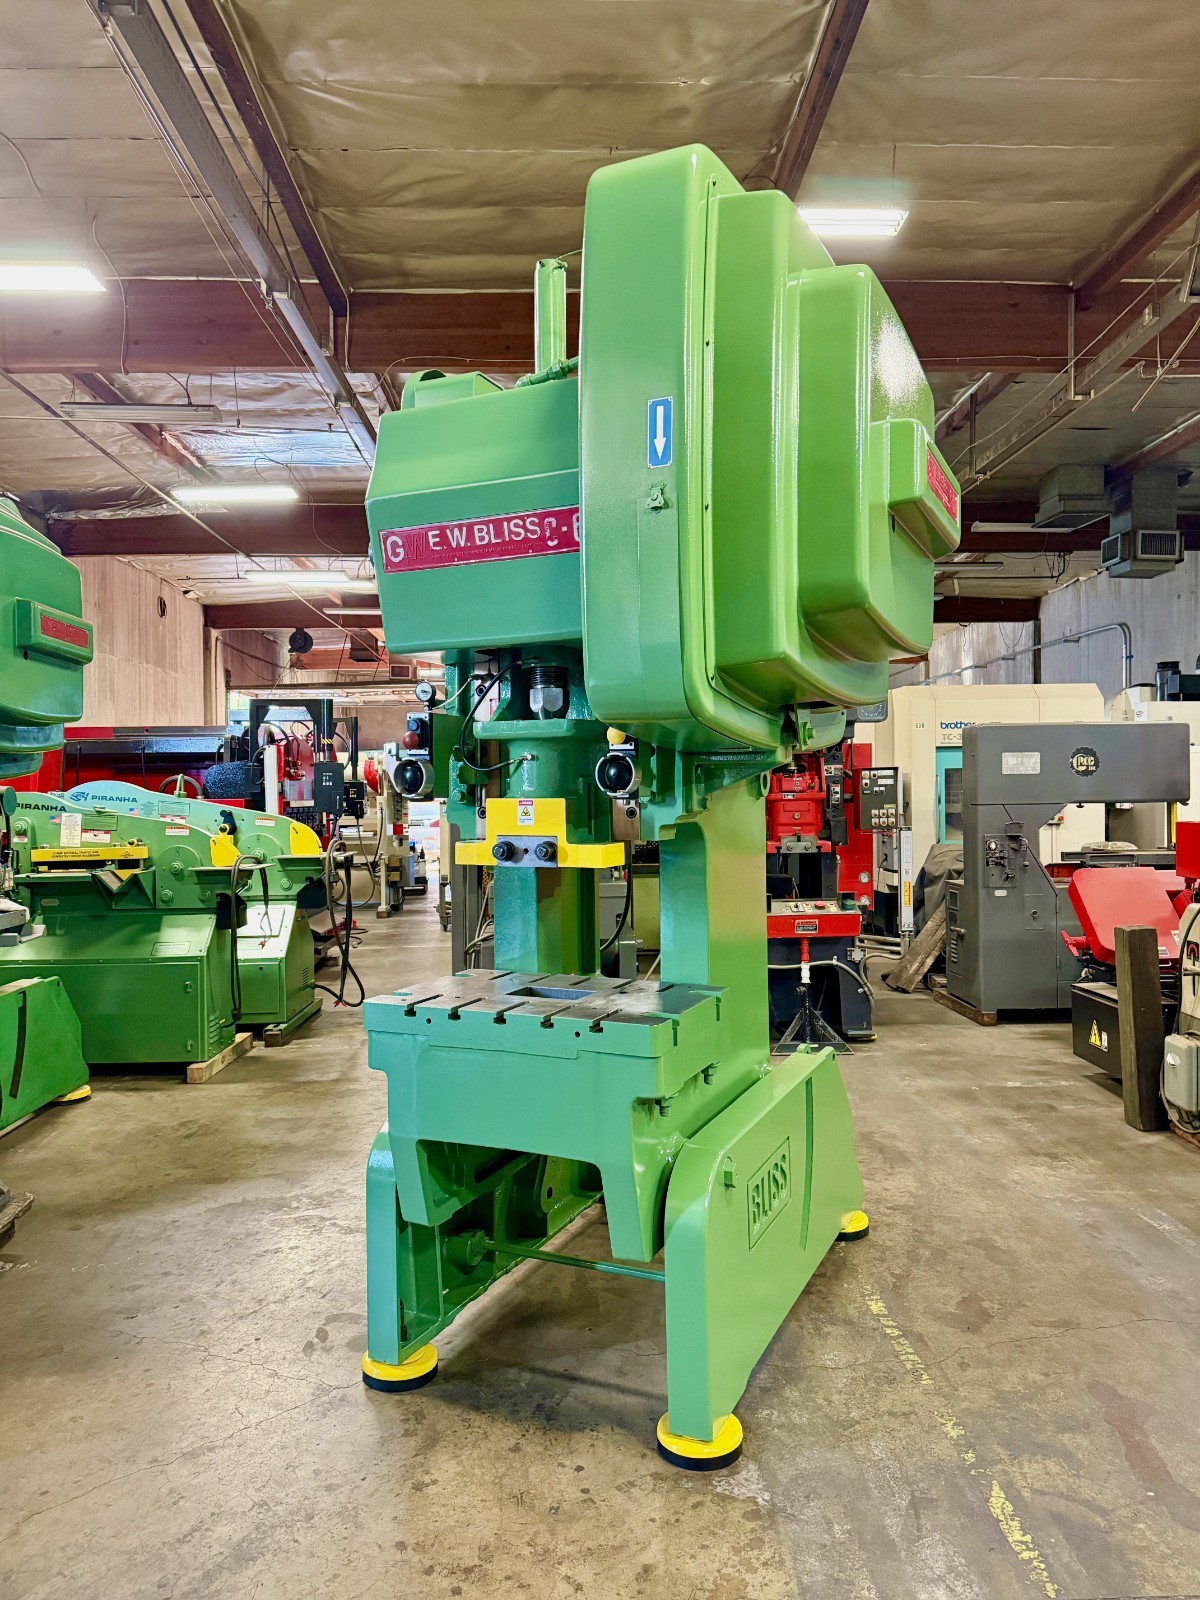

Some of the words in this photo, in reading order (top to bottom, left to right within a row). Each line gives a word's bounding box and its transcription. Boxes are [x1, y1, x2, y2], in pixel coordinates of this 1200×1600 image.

[474, 516, 541, 545] BLISS
[16, 802, 67, 813] PIRANHA
[91, 794, 138, 803] PIRANHA
[751, 1153, 788, 1233] BLISS
